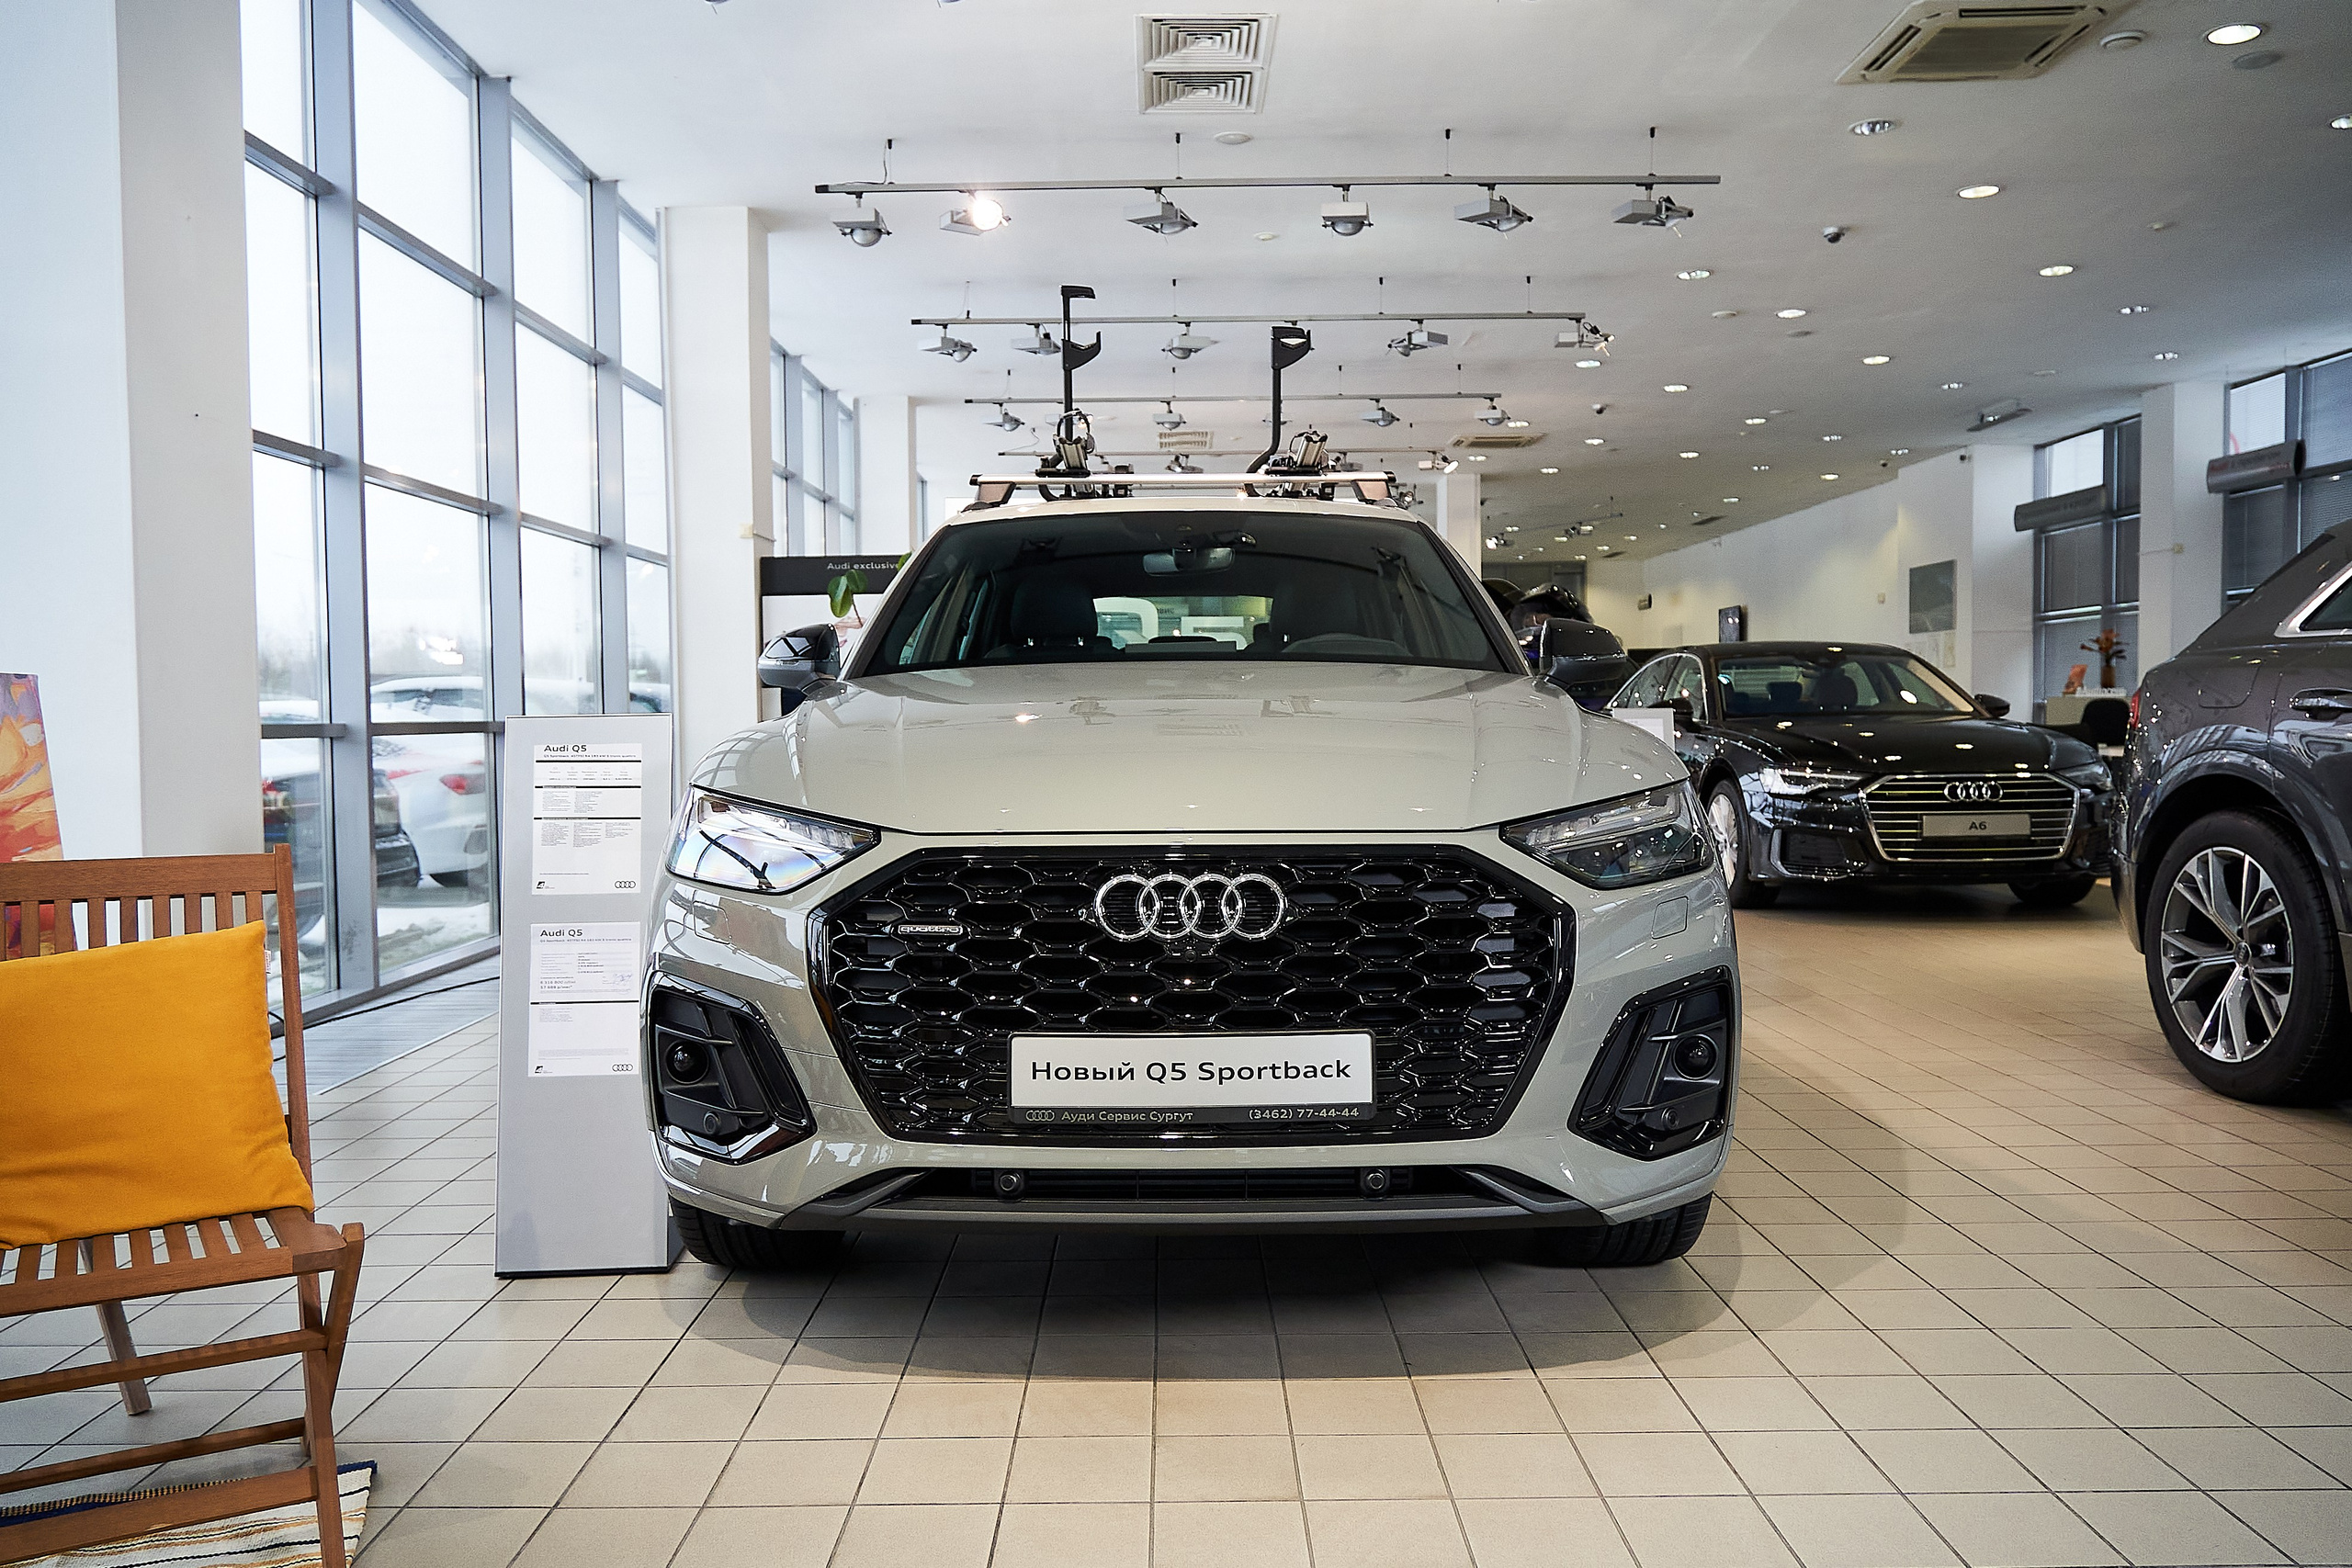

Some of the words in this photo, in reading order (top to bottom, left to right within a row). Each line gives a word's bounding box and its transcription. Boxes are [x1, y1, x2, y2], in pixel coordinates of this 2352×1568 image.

[571, 745, 587, 753] Q5
[1969, 821, 1987, 830] A6
[540, 929, 565, 937] Audi
[568, 929, 583, 938] Q5
[1031, 1061, 1135, 1081] Новый
[1146, 1062, 1187, 1085] Q5
[1198, 1059, 1351, 1086] Sportback
[1061, 1111, 1095, 1122] Ауди
[1100, 1111, 1146, 1122] Сервис
[1149, 1111, 1193, 1122] Сургут
[1249, 1109, 1293, 1120] (3462)
[1297, 1107, 1360, 1118] 77-44-44
